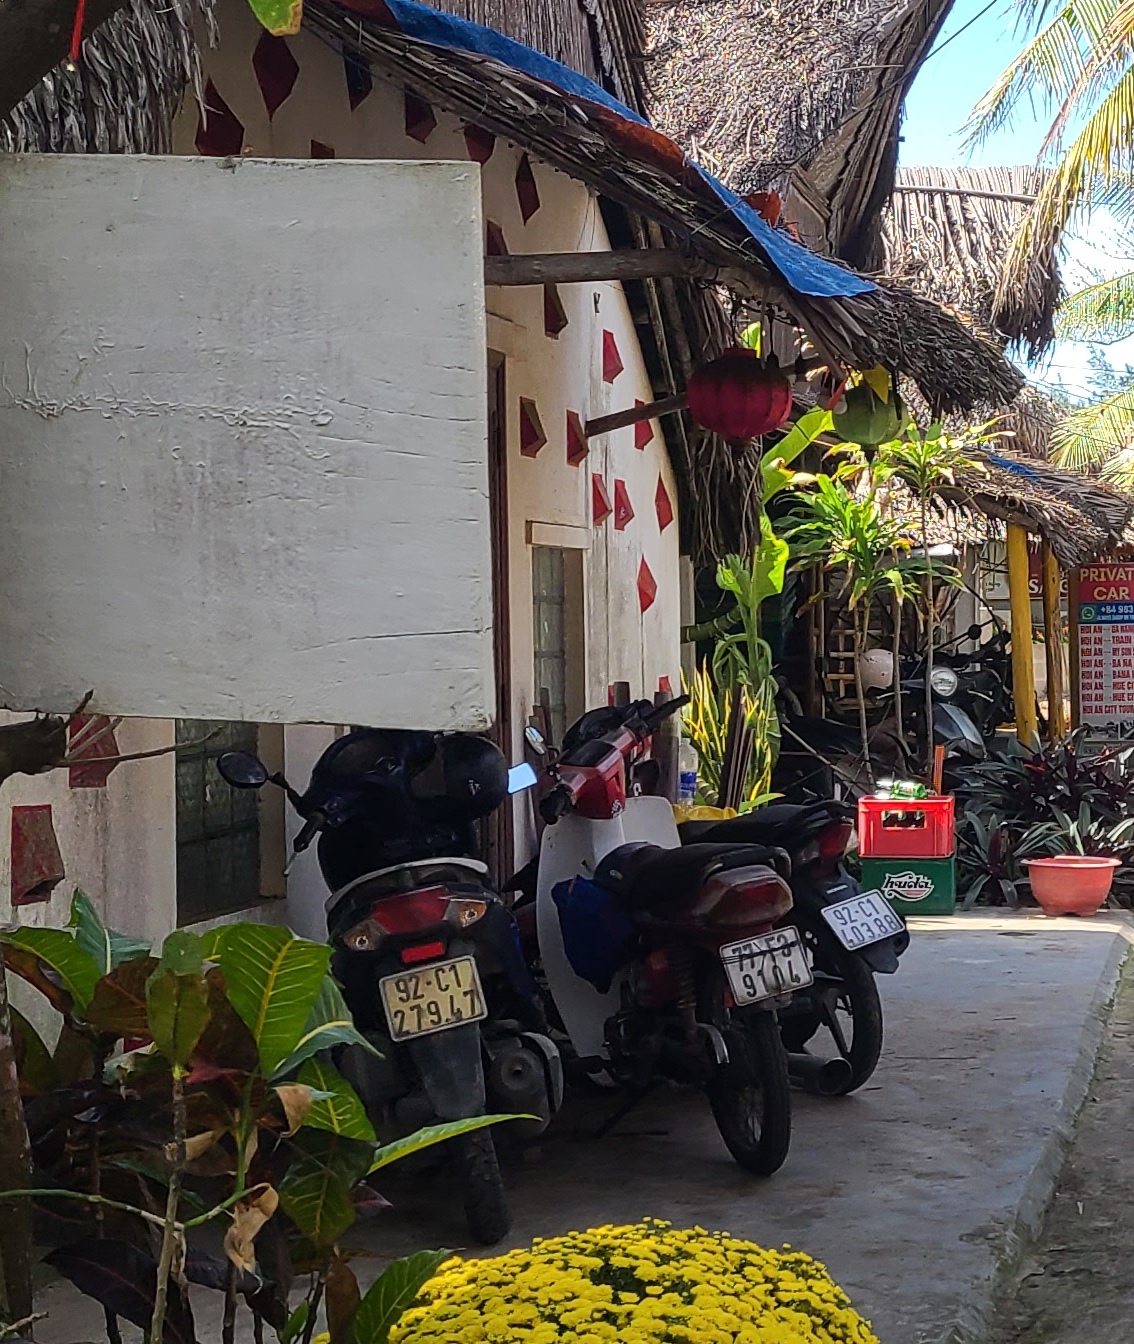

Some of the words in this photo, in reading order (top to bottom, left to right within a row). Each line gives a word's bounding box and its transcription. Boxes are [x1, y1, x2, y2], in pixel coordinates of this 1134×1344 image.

[1093, 586, 1131, 601] CAR
[1100, 604, 1116, 614] +84
[833, 898, 880, 926] 92-C1
[841, 914, 899, 947] 403.88
[731, 933, 792, 972] 77F3
[394, 964, 462, 1003] 92-C1
[742, 960, 801, 997] 9104
[393, 989, 477, 1035] 279.47
